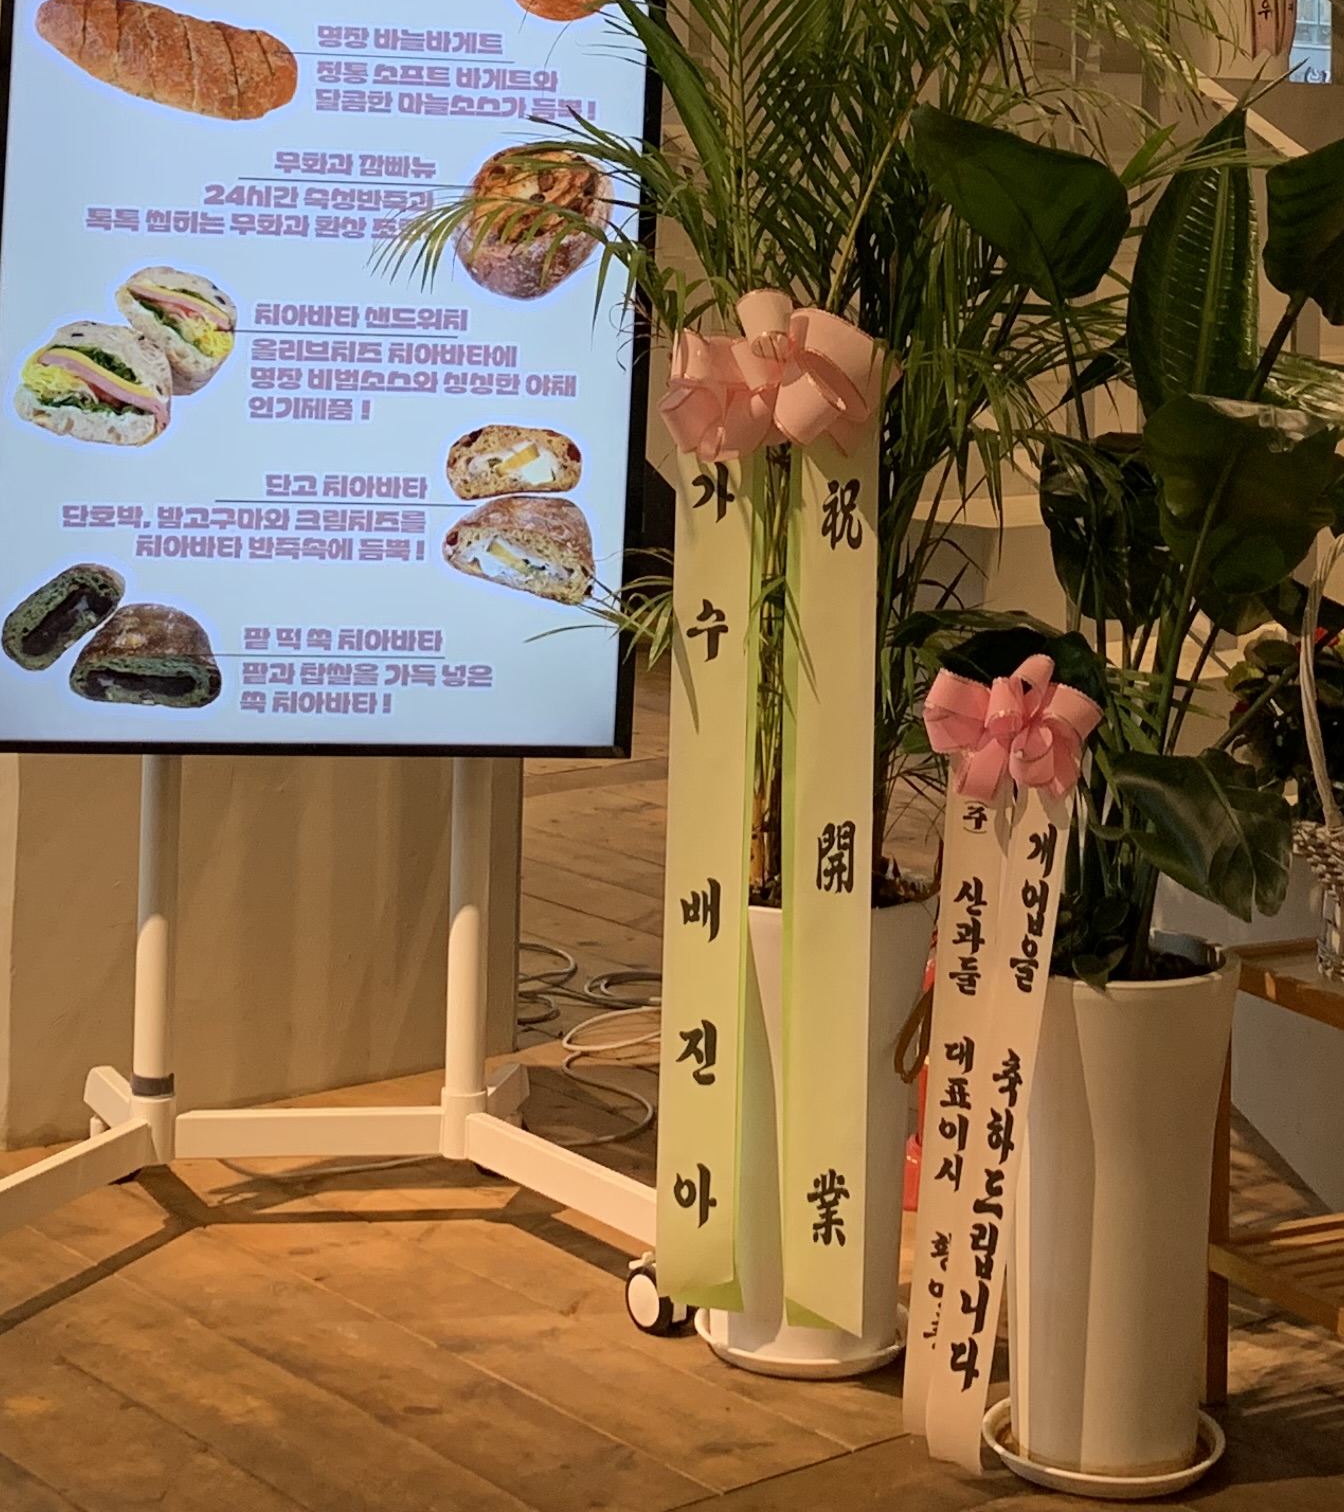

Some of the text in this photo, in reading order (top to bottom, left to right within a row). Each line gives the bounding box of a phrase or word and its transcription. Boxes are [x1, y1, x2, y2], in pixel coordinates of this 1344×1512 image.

[317, 25, 504, 55] 명장 바늘바게트
[316, 60, 559, 93] 정통 소프트 바게트와
[315, 89, 393, 113] 달콤한
[398, 91, 527, 119] 마늘소스가
[274, 150, 437, 179] 무화과 깜빠뉴
[204, 184, 434, 213] 24시간 숙성반죽과
[86, 207, 140, 232] 톡톡
[145, 209, 225, 235] 씹히는
[230, 213, 310, 238] 무화과
[314, 215, 368, 240] 환상
[255, 303, 469, 332] 치아바타 샌드위치
[251, 338, 518, 368] 올리브치즈 치아바타에
[250, 367, 302, 390] 명장
[443, 372, 521, 396] 싱싱한
[525, 374, 577, 398] 야채
[248, 395, 371, 420] 인기제품 !
[265, 473, 428, 500] 단고 치아바타
[62, 504, 426, 534] 단호박, 밤고구마와 크림치즈를
[136, 535, 425, 561] 치아바타 반죽속에 듬뿍 !
[243, 627, 444, 652] 팥 떡 쑥 치아바타
[242, 661, 296, 685] 팥과
[384, 663, 437, 687] 가득
[441, 664, 494, 688] 넣은
[239, 690, 393, 715] 쑥 치아바타 !
[673, 461, 735, 1229] 가수 배진아
[949, 876, 988, 996] 산과들
[949, 823, 1058, 1392] 개업을 축하드립니다
